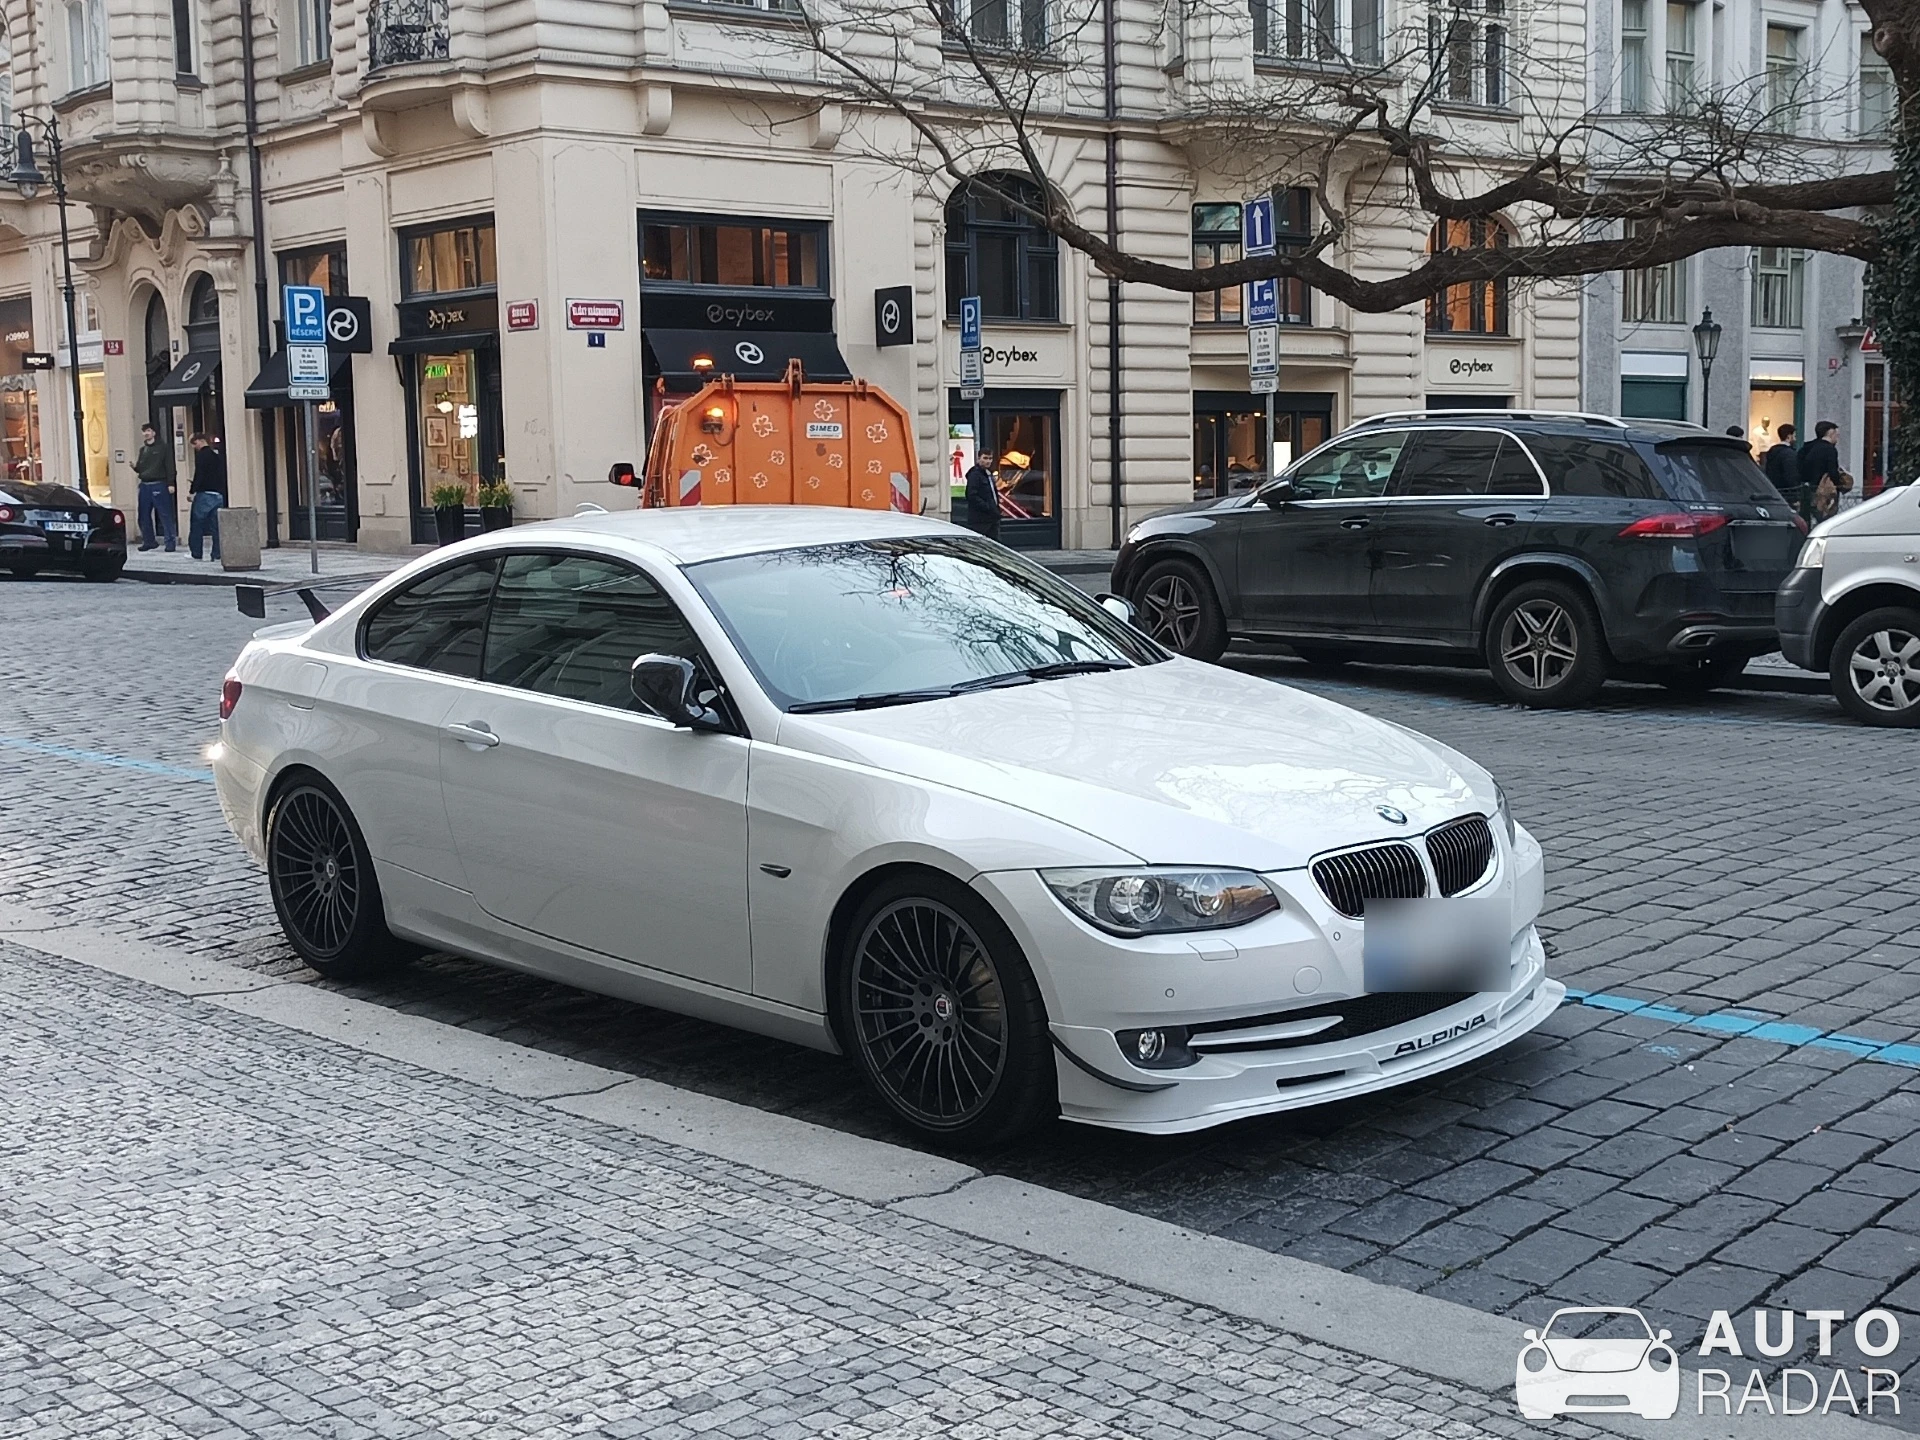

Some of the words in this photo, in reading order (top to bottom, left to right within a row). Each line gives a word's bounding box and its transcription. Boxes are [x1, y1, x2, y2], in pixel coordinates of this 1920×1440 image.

[294, 293, 315, 325] P
[725, 304, 775, 327] cybex
[964, 304, 976, 333] P
[996, 345, 1038, 368] cybex
[1461, 358, 1493, 377] cybex
[809, 424, 839, 432] SIMED
[1394, 1014, 1485, 1055] ALPINA
